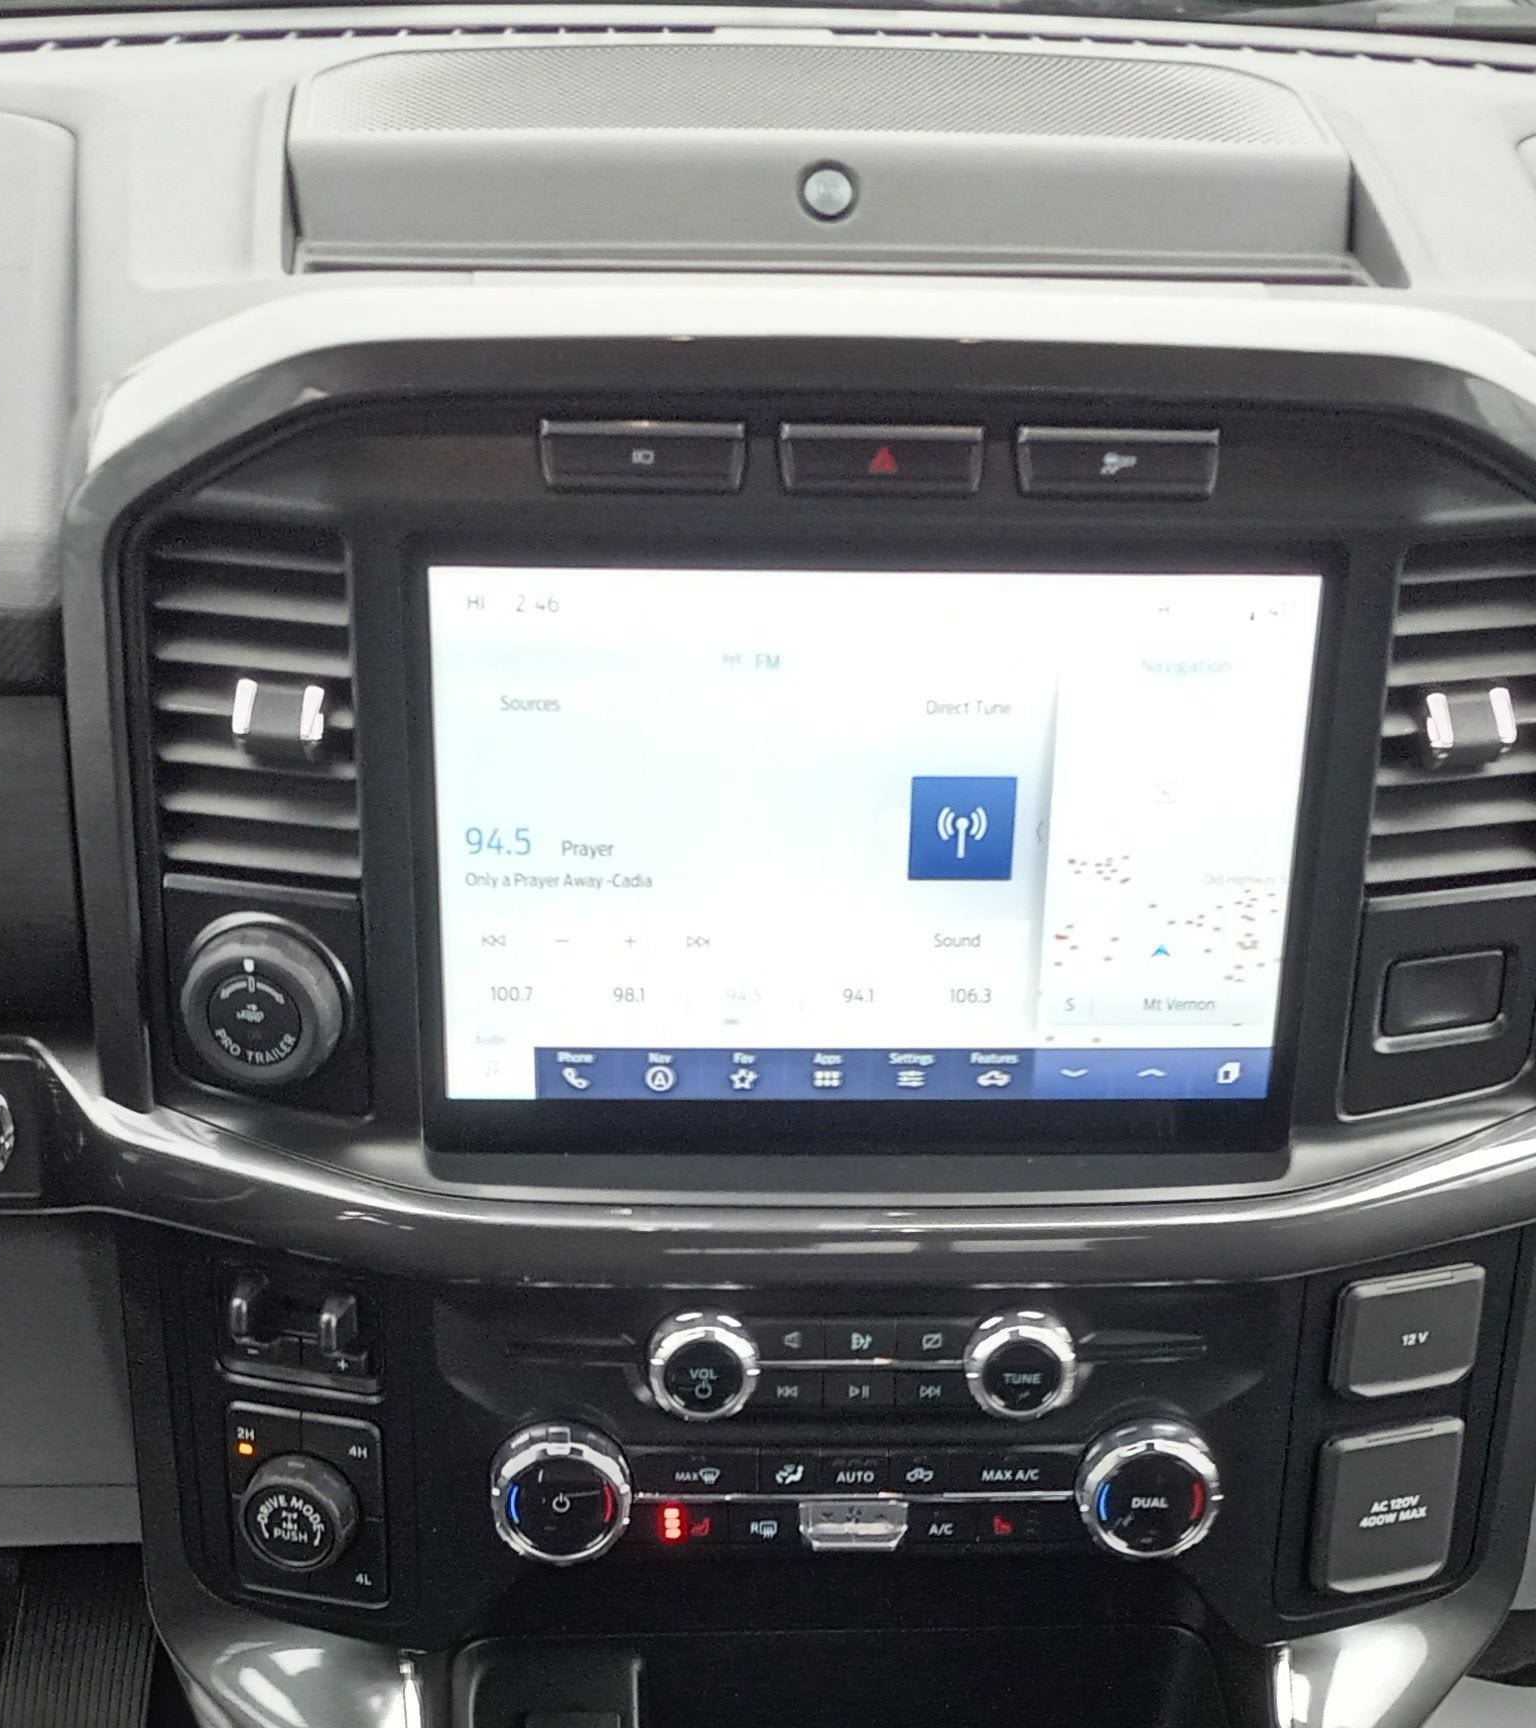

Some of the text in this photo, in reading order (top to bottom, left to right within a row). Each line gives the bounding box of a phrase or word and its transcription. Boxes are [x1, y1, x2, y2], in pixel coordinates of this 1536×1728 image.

[754, 654, 781, 670] FM
[500, 695, 561, 712] Sources
[926, 700, 1012, 715] Direct Tune
[465, 827, 614, 858] 94.5 Prayer
[465, 873, 499, 889] Only
[501, 876, 511, 888] a
[514, 873, 560, 889] Prayer
[563, 874, 603, 889] Away
[933, 933, 981, 948] Sound
[491, 986, 533, 1002] 100.7
[613, 987, 646, 1002] 98.1
[842, 988, 875, 1003] 94.1
[950, 988, 992, 1003] 106.3
[1143, 998, 1216, 1011] Mt Vernon
[215, 1028, 296, 1064] PRO TRAILER
[557, 1052, 594, 1063] Phone
[648, 1053, 672, 1063] Nav
[733, 1053, 755, 1063] Fav
[814, 1053, 842, 1065] Apps
[889, 1052, 935, 1065] Settings
[970, 1052, 1019, 1064] Features
[1402, 1330, 1430, 1347] 12 V
[689, 1368, 719, 1380] VOL
[1003, 1373, 1042, 1385] TUNE
[237, 1427, 255, 1441] 2H
[349, 1445, 367, 1459] 4H
[674, 1471, 699, 1482] MAX
[835, 1471, 875, 1484] AUTO
[981, 1469, 1040, 1482] MAX A/C
[1131, 1497, 1168, 1509] DUAL
[1370, 1494, 1421, 1514] AC 120V
[257, 1495, 324, 1531] DRIVE MODE
[1358, 1506, 1428, 1529] 400W MAX
[274, 1527, 308, 1543] PUSH
[928, 1523, 953, 1536] A/C
[356, 1573, 372, 1586] 4L
